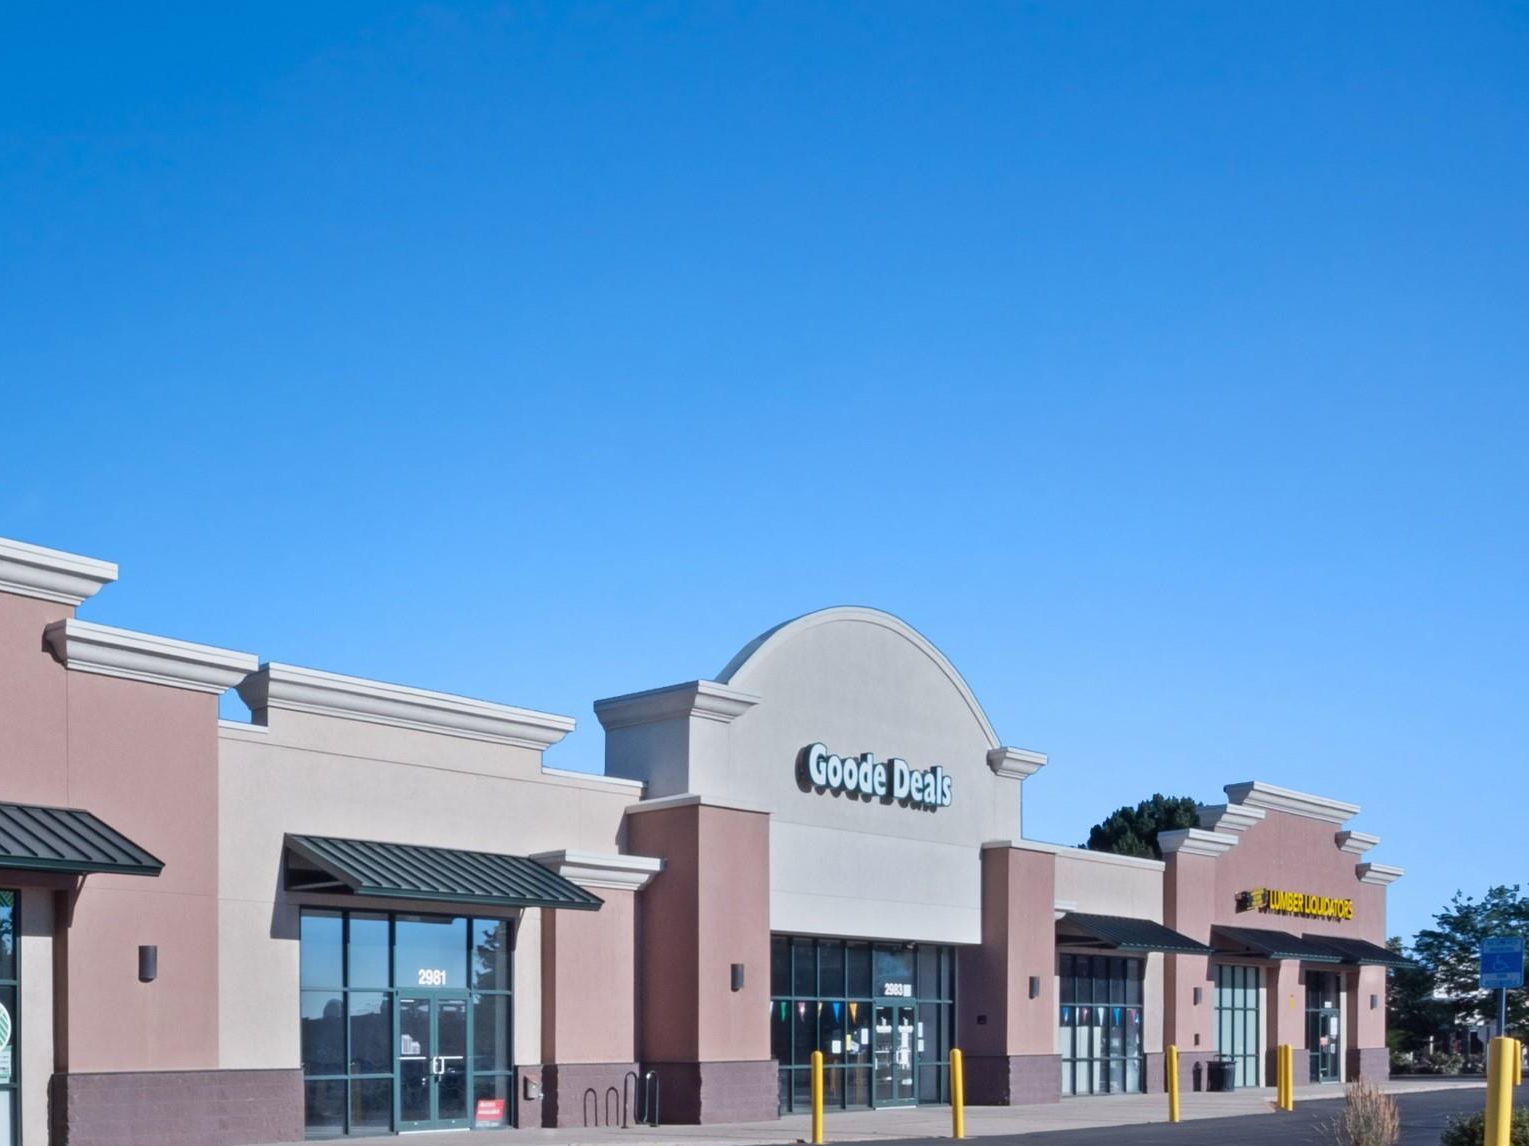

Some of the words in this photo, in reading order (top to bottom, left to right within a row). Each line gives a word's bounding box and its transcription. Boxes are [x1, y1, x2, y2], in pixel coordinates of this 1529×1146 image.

[807, 742, 888, 796] Goode
[892, 758, 952, 807] Deals
[1269, 889, 1304, 913] LUMBER
[1304, 895, 1353, 920] LIQUIDATORS
[418, 968, 447, 985] 2981
[884, 982, 903, 996] 2983
